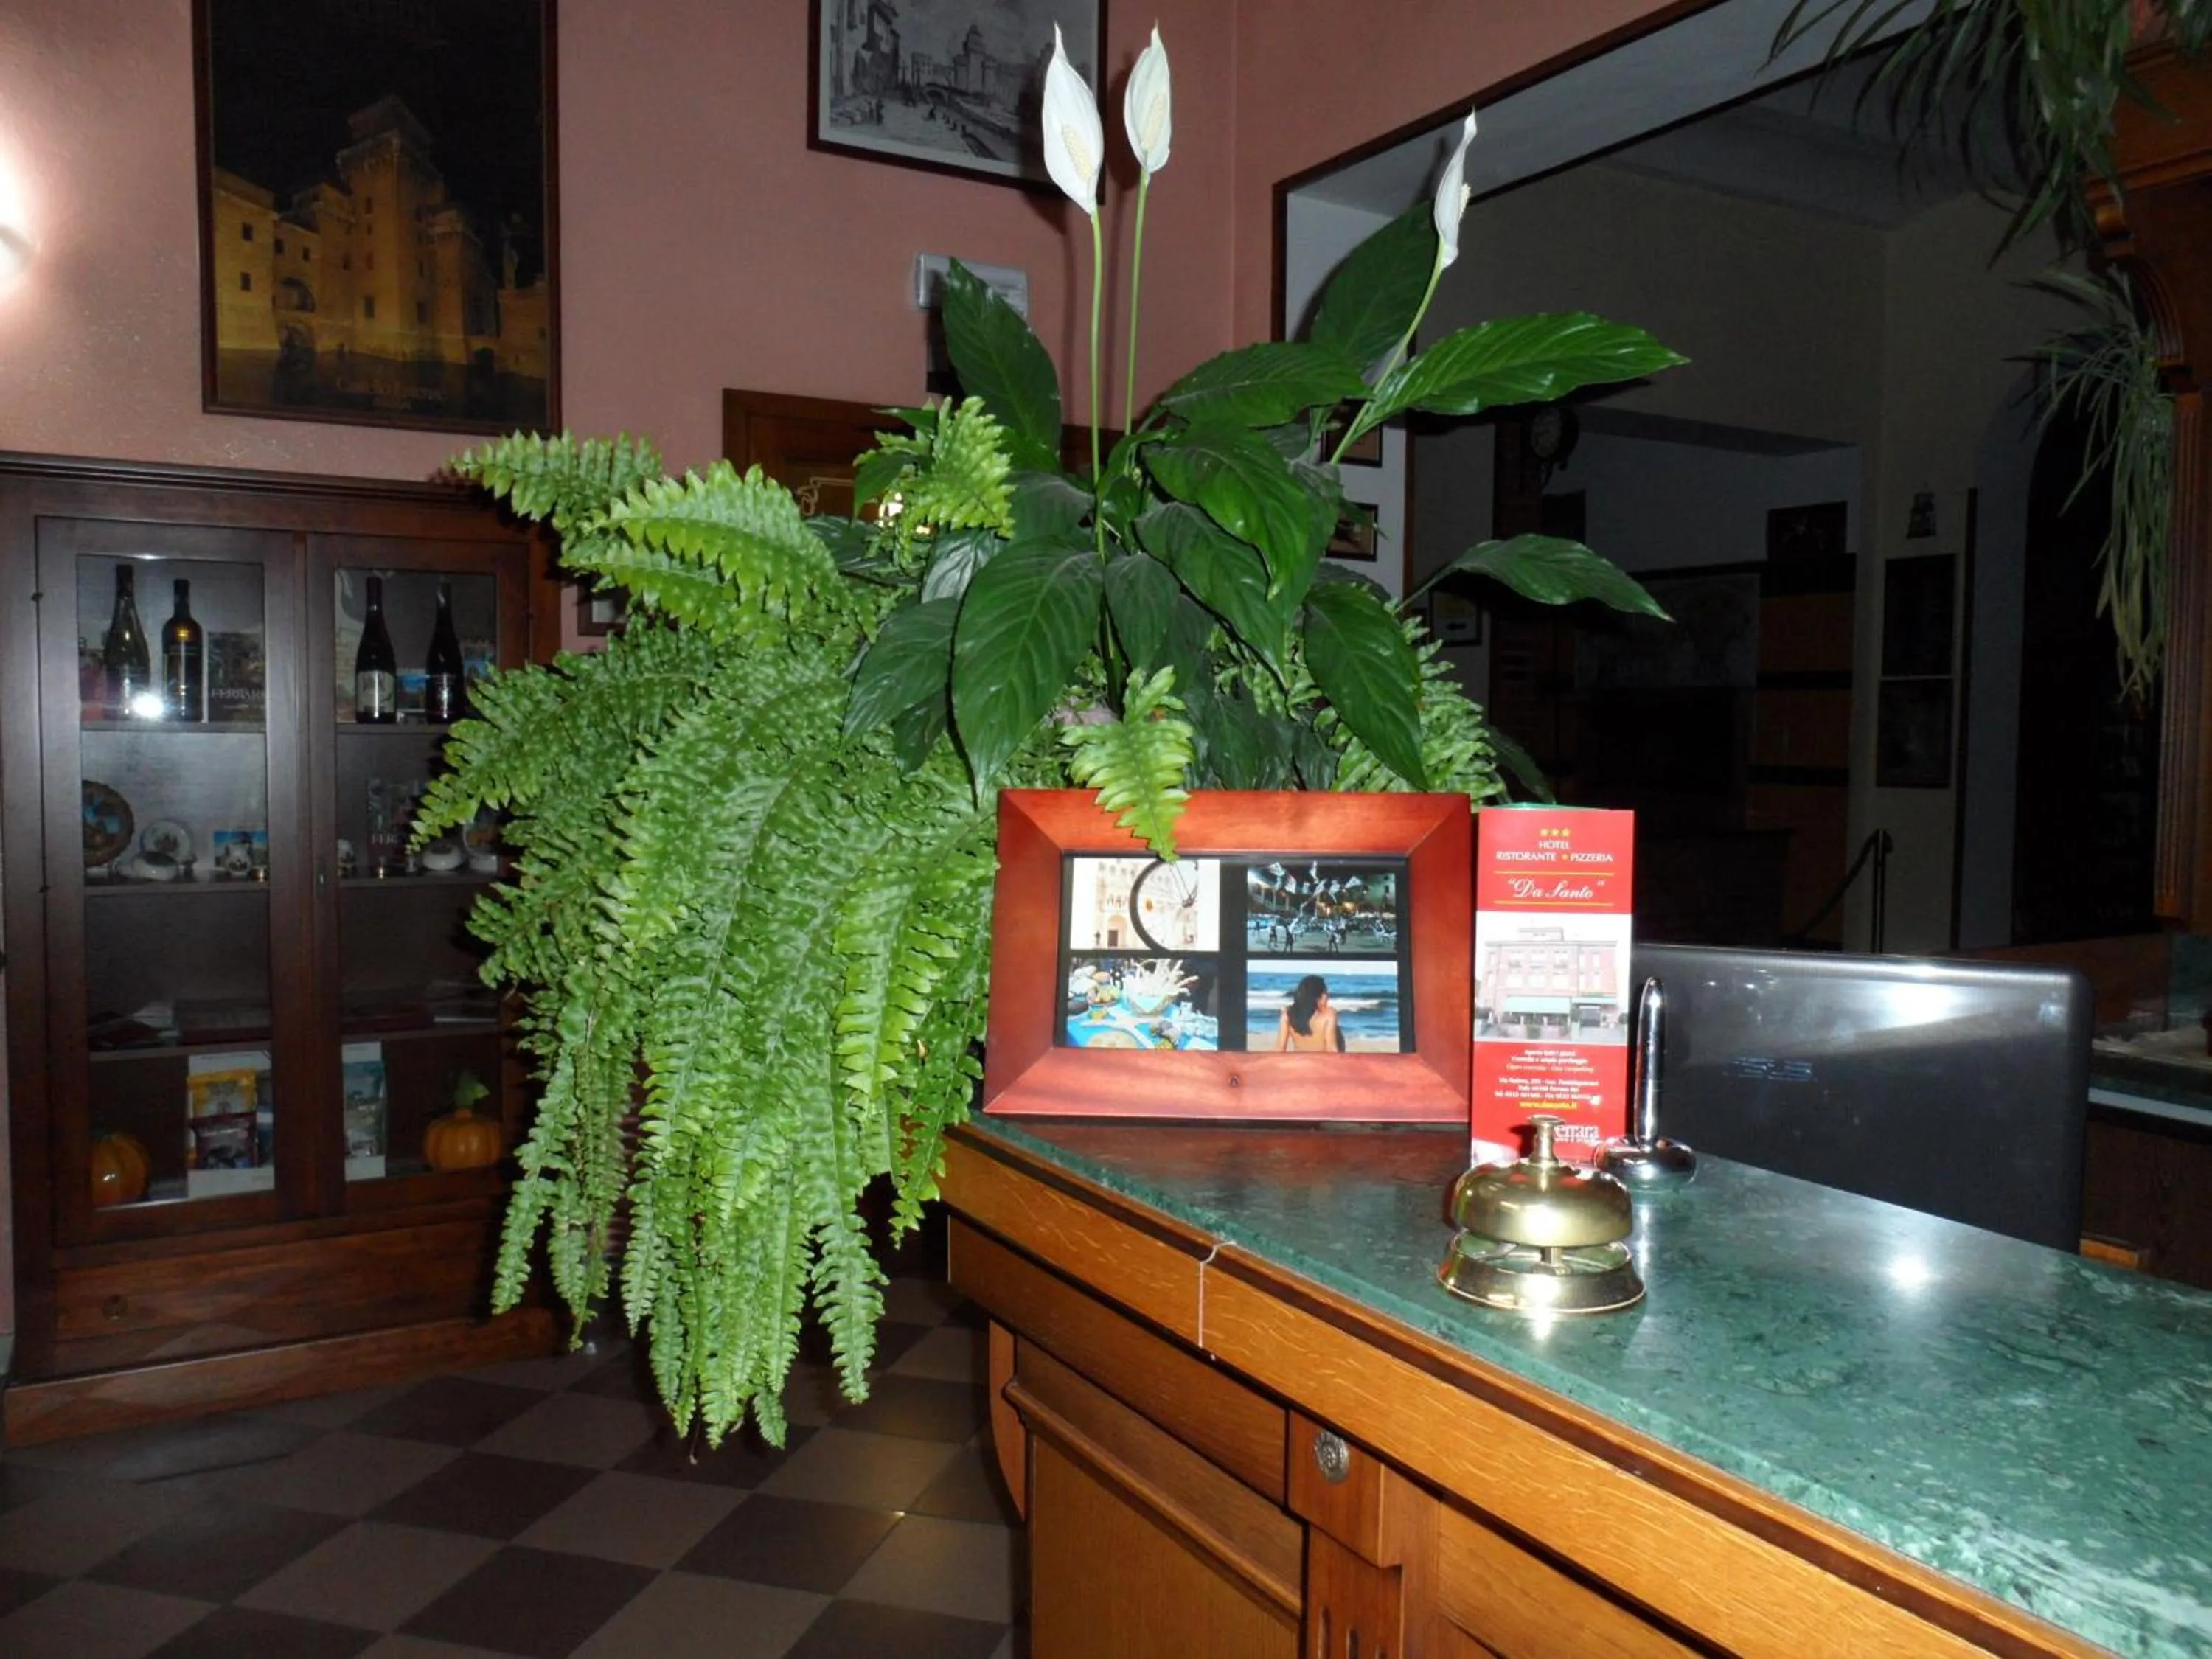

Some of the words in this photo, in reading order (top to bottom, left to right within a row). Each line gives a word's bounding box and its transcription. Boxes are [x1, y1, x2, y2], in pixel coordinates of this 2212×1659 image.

[1538, 840, 1570, 849] HOTEL
[1495, 851, 1557, 862] RISTORANTE
[1569, 853, 1613, 862] PIZZERIA
